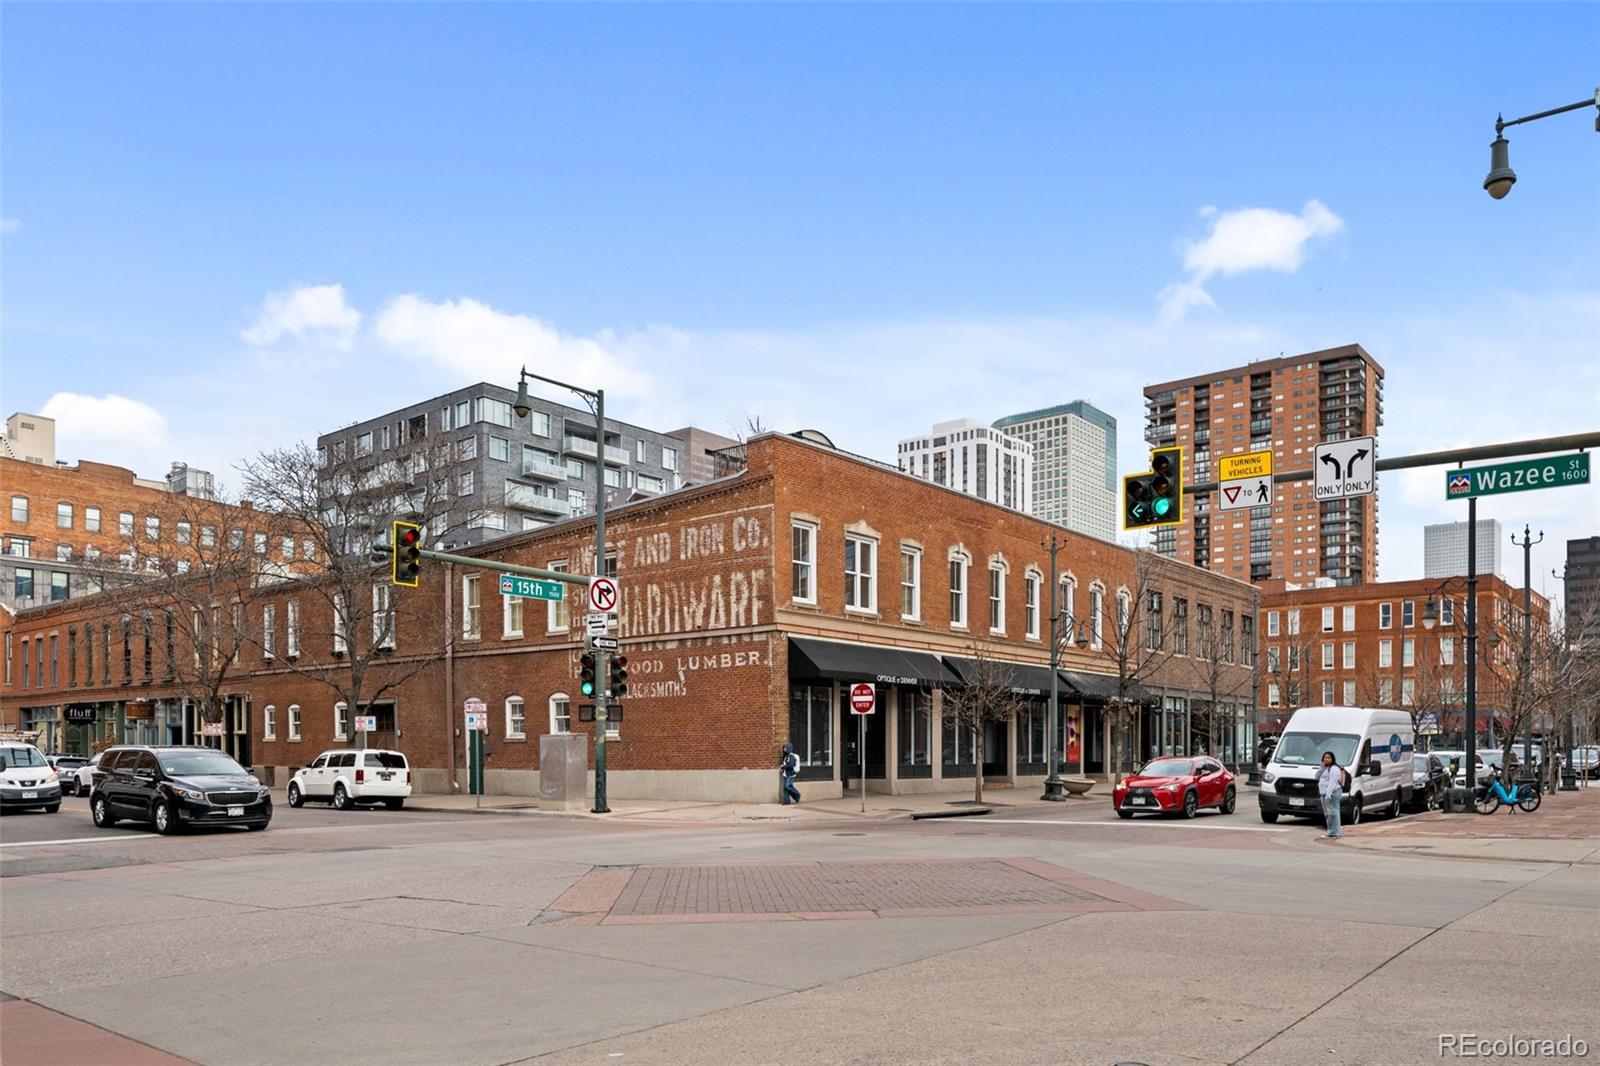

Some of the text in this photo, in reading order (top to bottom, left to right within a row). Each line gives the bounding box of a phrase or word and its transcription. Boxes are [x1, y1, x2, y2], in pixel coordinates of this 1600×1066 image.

[1230, 456, 1262, 466] TURNING
[1228, 465, 1264, 477] VEHICLES
[1476, 465, 1556, 491] Wazee
[1569, 460, 1580, 469] St
[1562, 470, 1588, 480] 1600
[1317, 484, 1342, 496] ONLY
[1345, 480, 1371, 492] ONLY
[1243, 489, 1253, 497] TO
[633, 531, 672, 568] AND
[679, 522, 725, 561] IRON
[732, 515, 769, 553] CO.
[516, 581, 543, 596] 15th
[677, 651, 770, 672] LUMBER.
[69, 708, 92, 717] fluff
